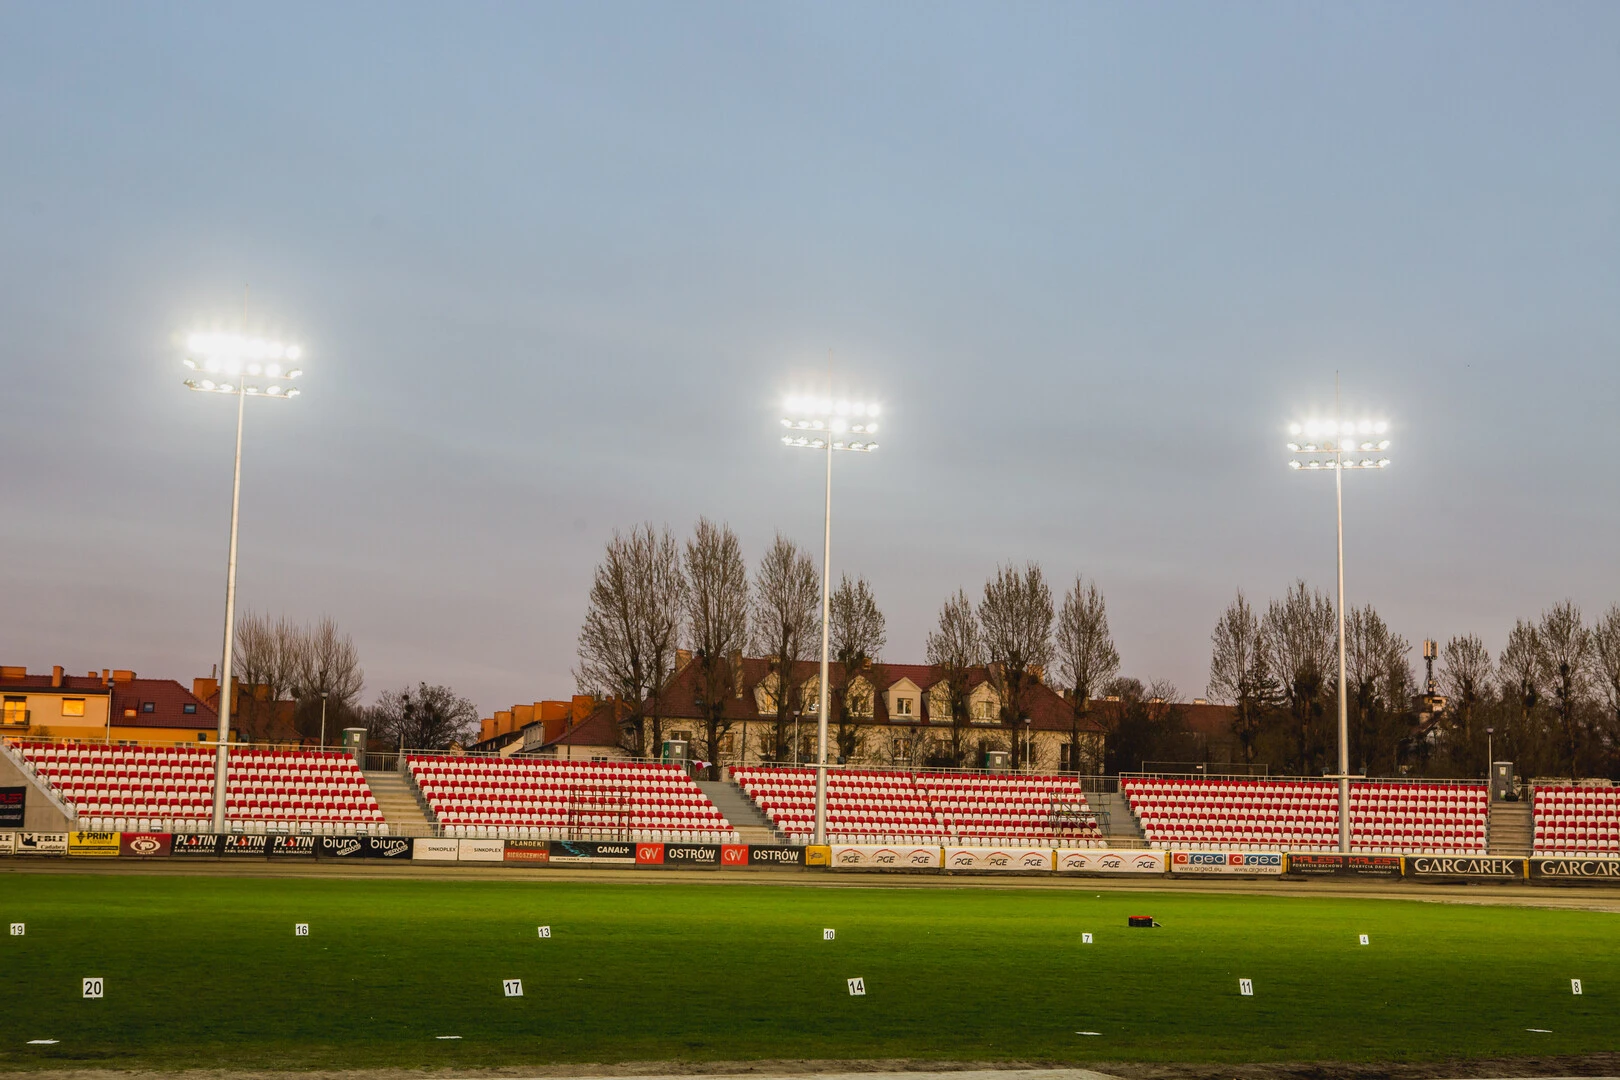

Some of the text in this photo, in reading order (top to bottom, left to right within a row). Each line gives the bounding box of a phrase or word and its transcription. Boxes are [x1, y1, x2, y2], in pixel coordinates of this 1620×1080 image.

[175, 834, 218, 846] PLATIN
[225, 835, 267, 847] PLATIN
[274, 836, 315, 848] PLATIN
[323, 836, 358, 848] biuro
[370, 837, 405, 849] biuro
[597, 846, 629, 854] CANAL+
[669, 847, 715, 859] OSTRÓW
[753, 848, 799, 860] OSTRÓW
[990, 858, 1008, 866] PGE
[1177, 854, 1225, 865] arged
[1232, 855, 1280, 865] arged
[1414, 858, 1515, 874] GARCAREK
[11, 925, 23, 935] 19
[297, 925, 308, 935] 16
[539, 928, 550, 937] 13
[825, 930, 834, 939] 10
[1084, 934, 1090, 942] 7
[84, 981, 102, 995] 20
[505, 982, 520, 994] 17
[849, 980, 864, 993] 14
[1241, 981, 1252, 993] 11
[1574, 981, 1580, 992] 8
